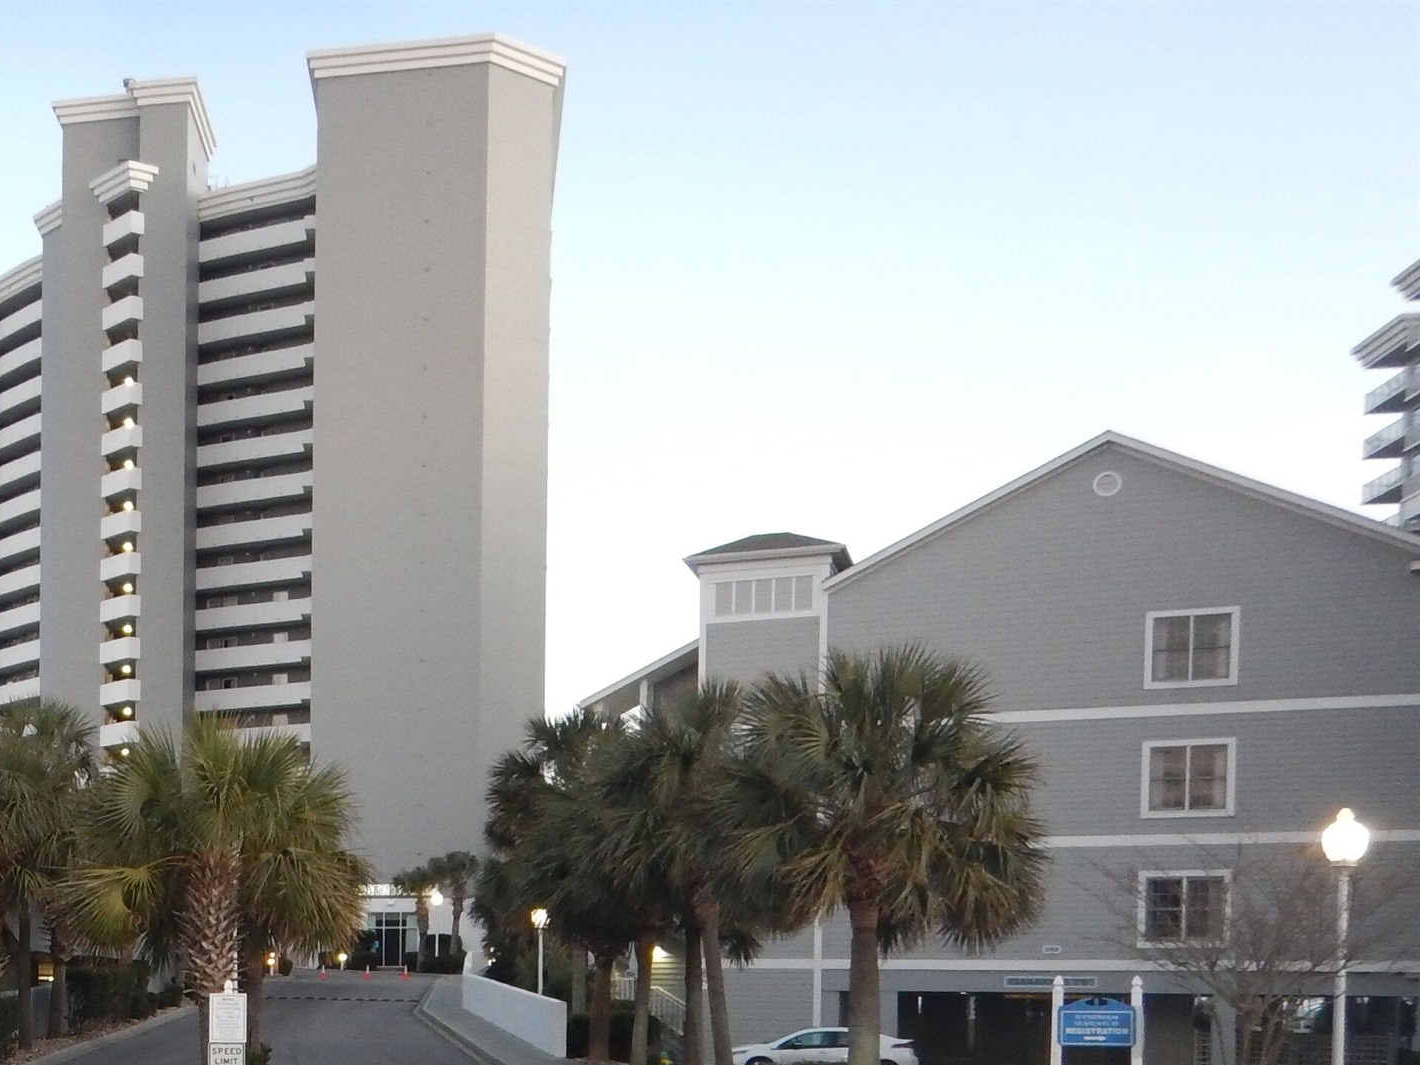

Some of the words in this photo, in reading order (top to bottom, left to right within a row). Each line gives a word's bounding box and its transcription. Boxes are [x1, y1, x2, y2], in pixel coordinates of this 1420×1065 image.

[1065, 1027, 1129, 1035] REGISTRATION
[211, 1047, 242, 1055] SPEED
[214, 1057, 239, 1065] LIMIT
